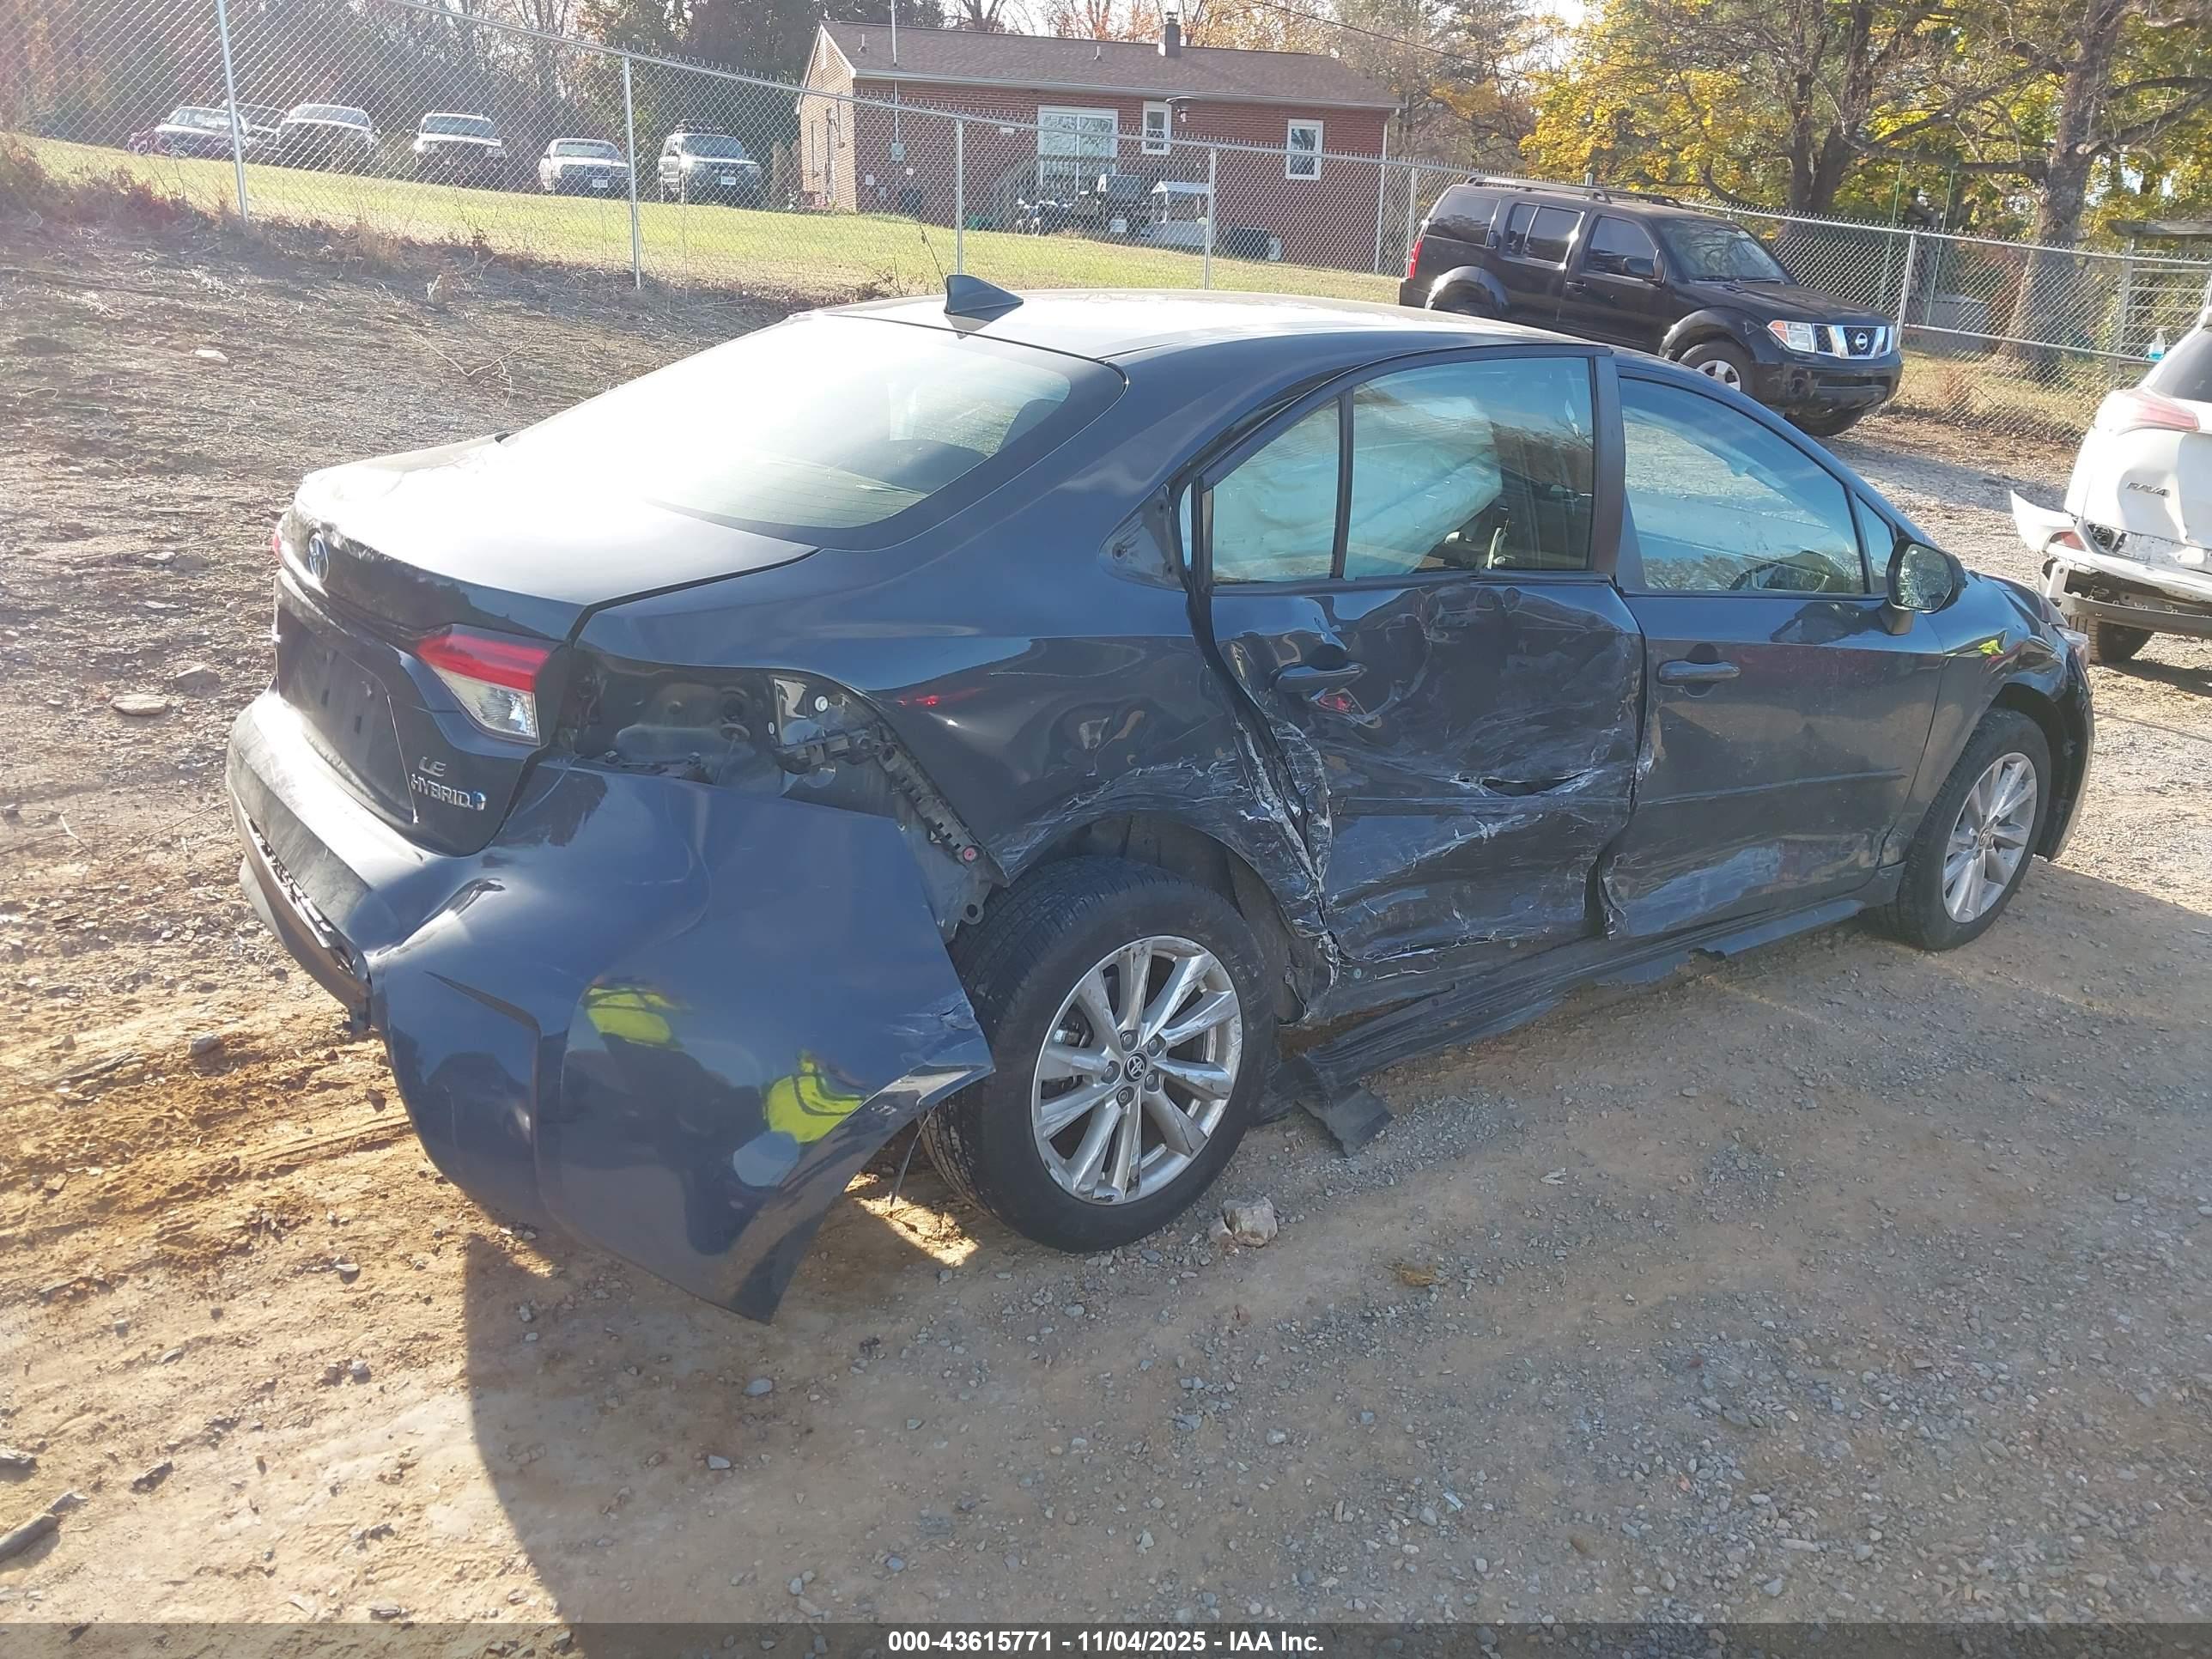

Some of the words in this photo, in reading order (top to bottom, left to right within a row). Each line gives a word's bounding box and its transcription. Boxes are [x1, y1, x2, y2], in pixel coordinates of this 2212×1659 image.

[2125, 481, 2167, 497] RAV4
[418, 756, 447, 777] LE
[410, 773, 472, 809] HYBRID
